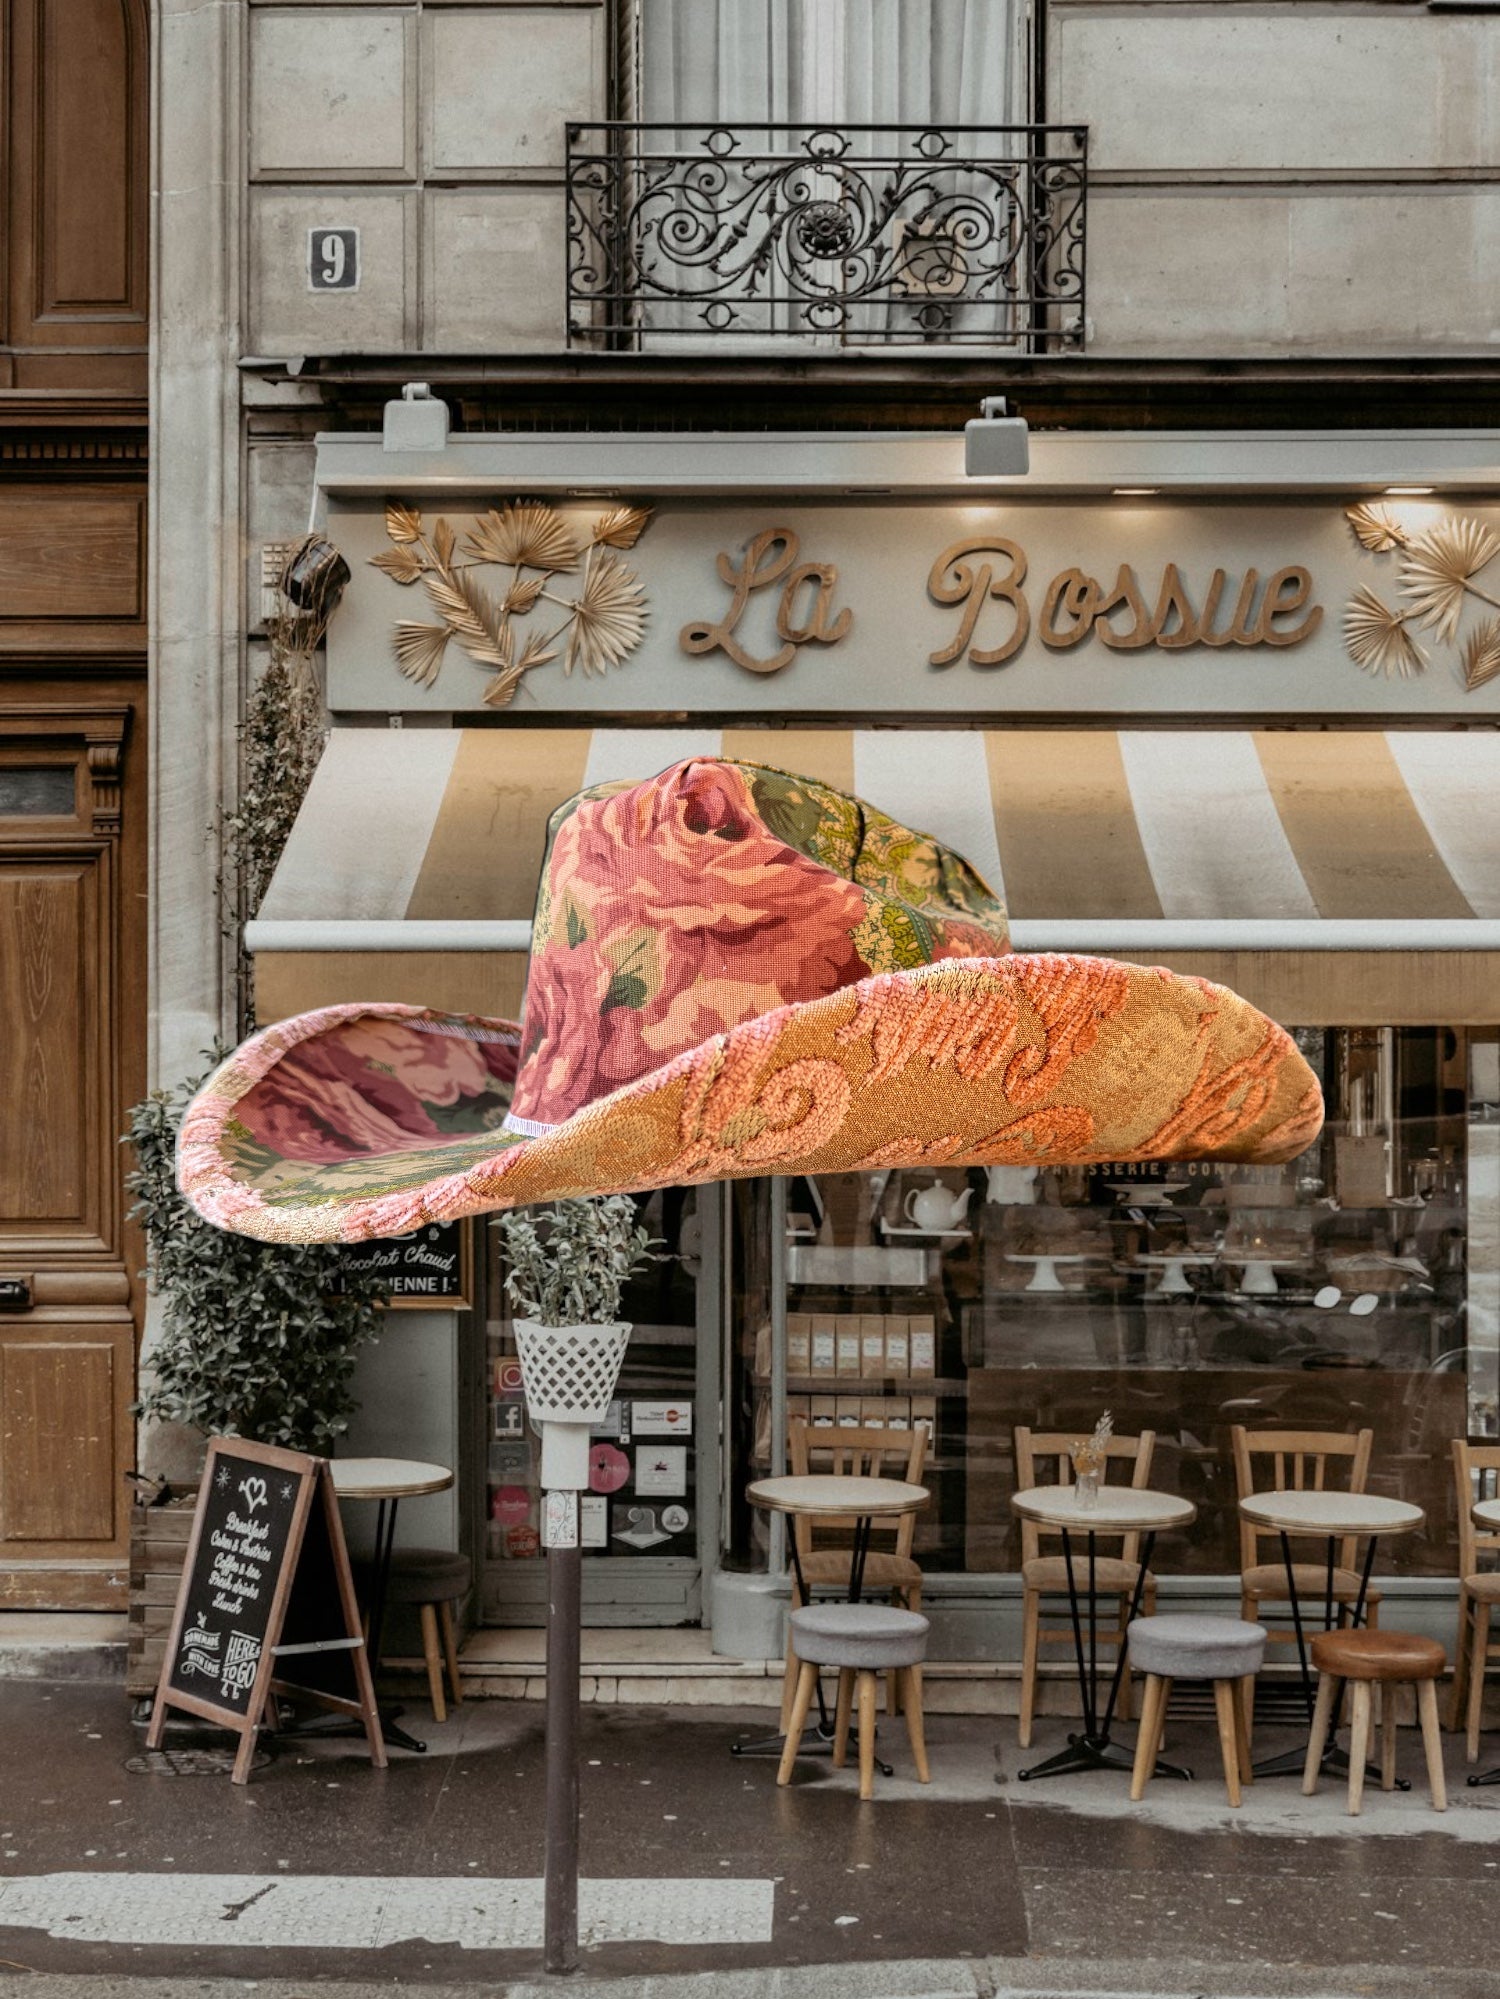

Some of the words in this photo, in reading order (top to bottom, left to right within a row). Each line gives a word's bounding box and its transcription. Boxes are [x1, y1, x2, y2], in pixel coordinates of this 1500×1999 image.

[322, 234, 345, 284] 9
[679, 527, 852, 674] La
[928, 536, 1324, 667] Bossue
[1188, 1162, 1287, 1176] COMPTR
[336, 1248, 399, 1271] hocolat
[404, 1243, 456, 1271] Chaud
[225, 1511, 270, 1540] Breakfast
[225, 1635, 257, 1663] HERE
[222, 1665, 237, 1680] TO
[237, 1661, 257, 1689] GO
